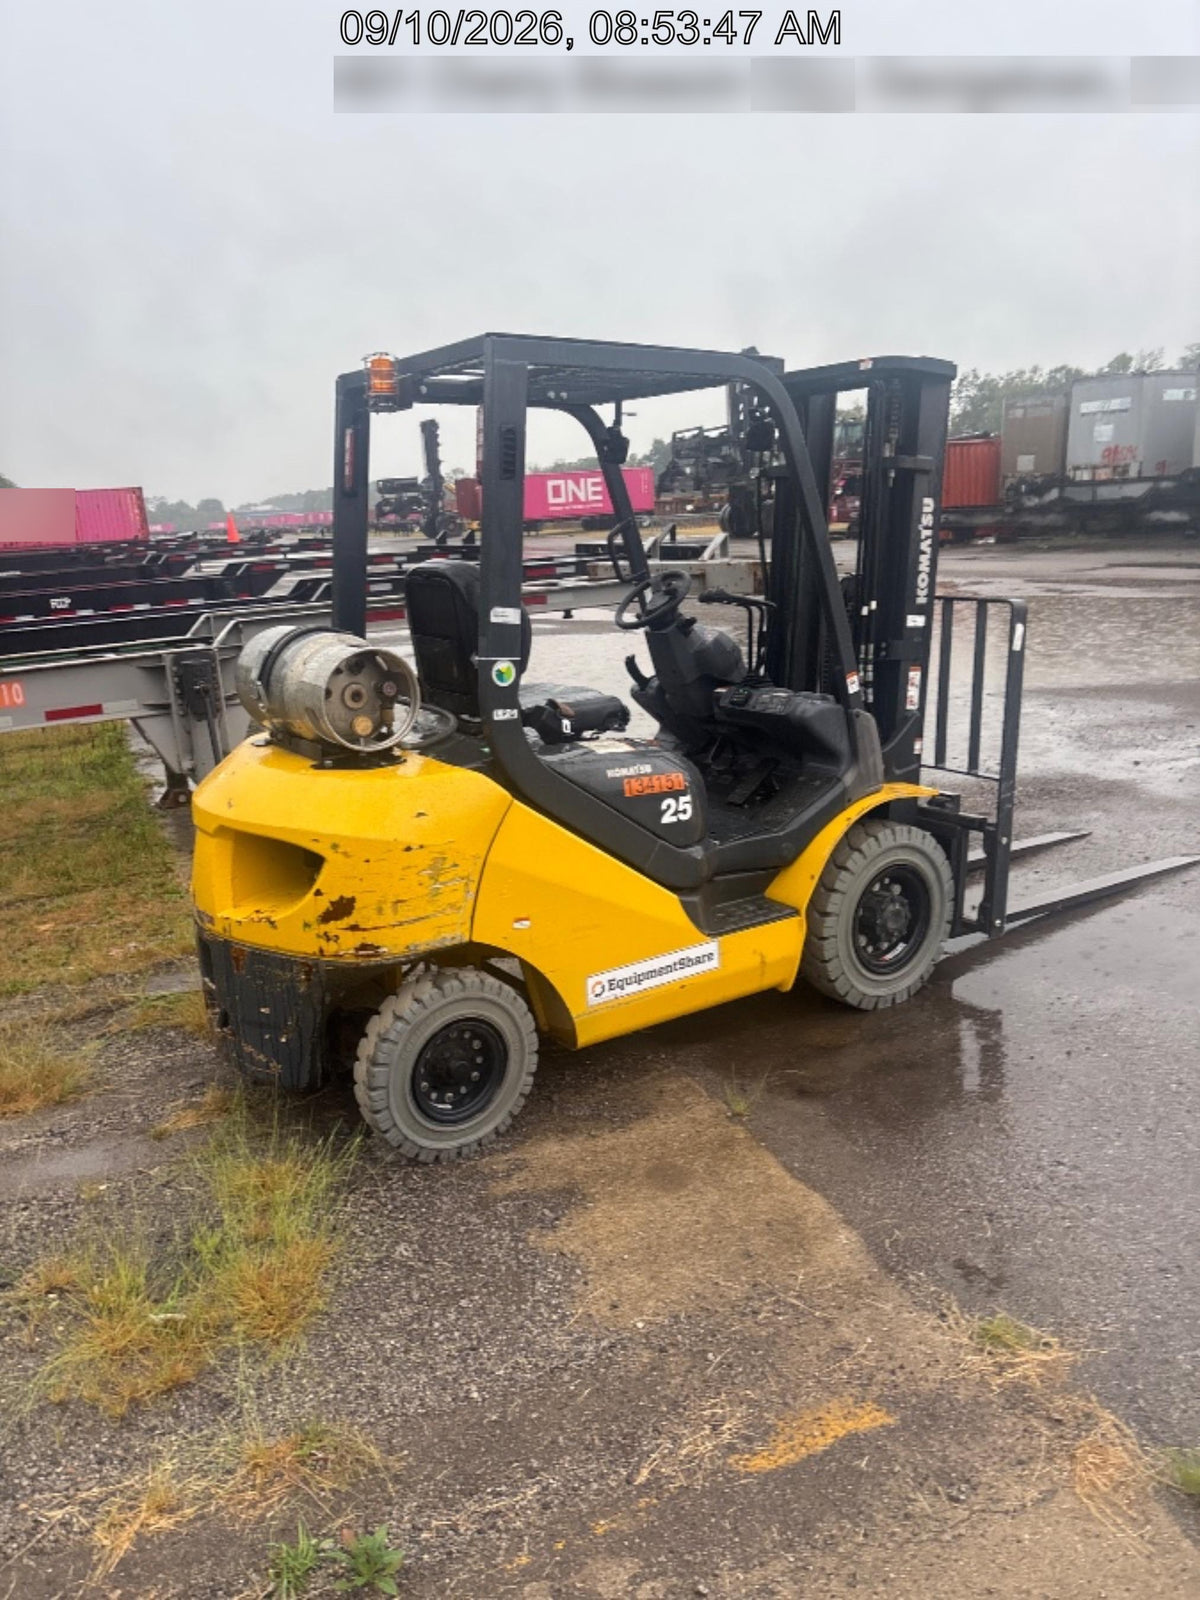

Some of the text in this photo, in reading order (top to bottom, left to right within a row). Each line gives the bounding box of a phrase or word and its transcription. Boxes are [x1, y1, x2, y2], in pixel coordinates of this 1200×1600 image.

[547, 478, 603, 503] ONE
[915, 497, 935, 604] KOMATSU
[661, 795, 693, 823] 25
[607, 952, 714, 991] EquipmentShare
